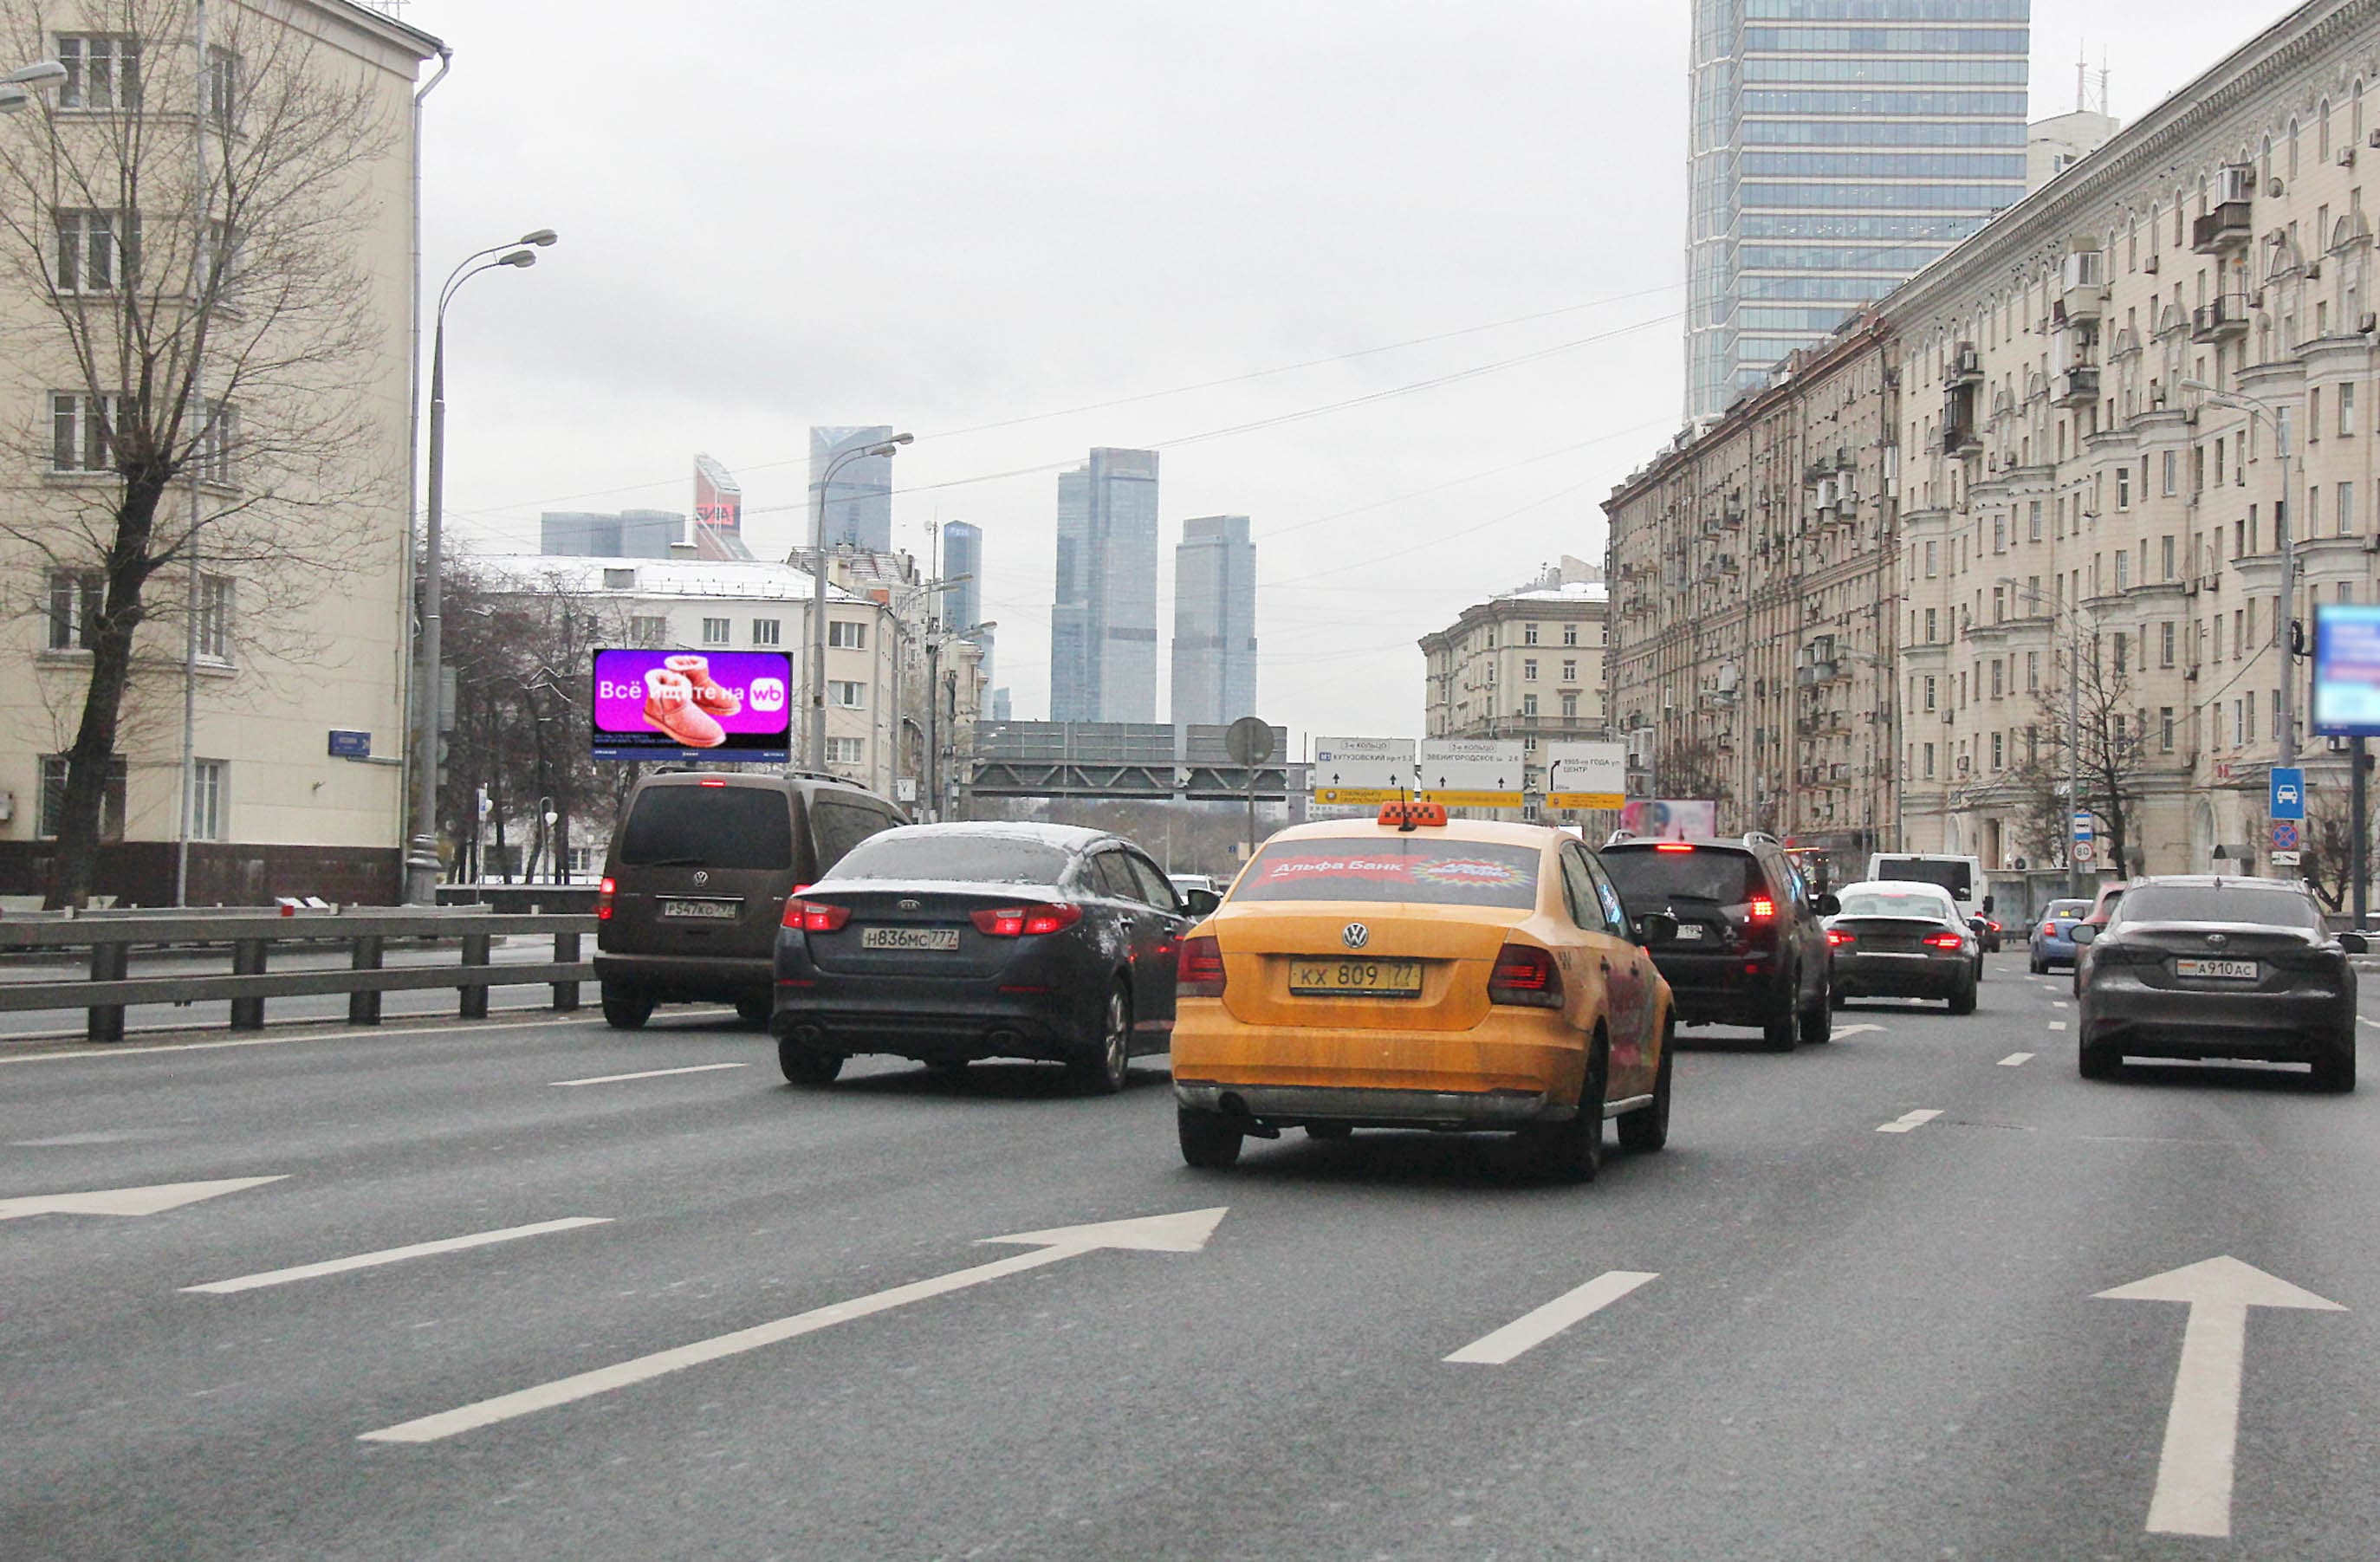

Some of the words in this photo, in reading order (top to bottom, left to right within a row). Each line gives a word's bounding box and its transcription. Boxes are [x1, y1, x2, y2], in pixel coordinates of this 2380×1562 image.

[600, 681, 642, 698] Всё
[650, 686, 717, 703] ищте
[721, 687, 745, 700] на
[752, 684, 782, 702] wb
[1464, 743, 1495, 752] КОЛЬЦО
[2076, 846, 2090, 857] 80
[1271, 860, 1343, 877] Альфа
[1348, 859, 1402, 872] Банк
[1337, 964, 1378, 986] 809
